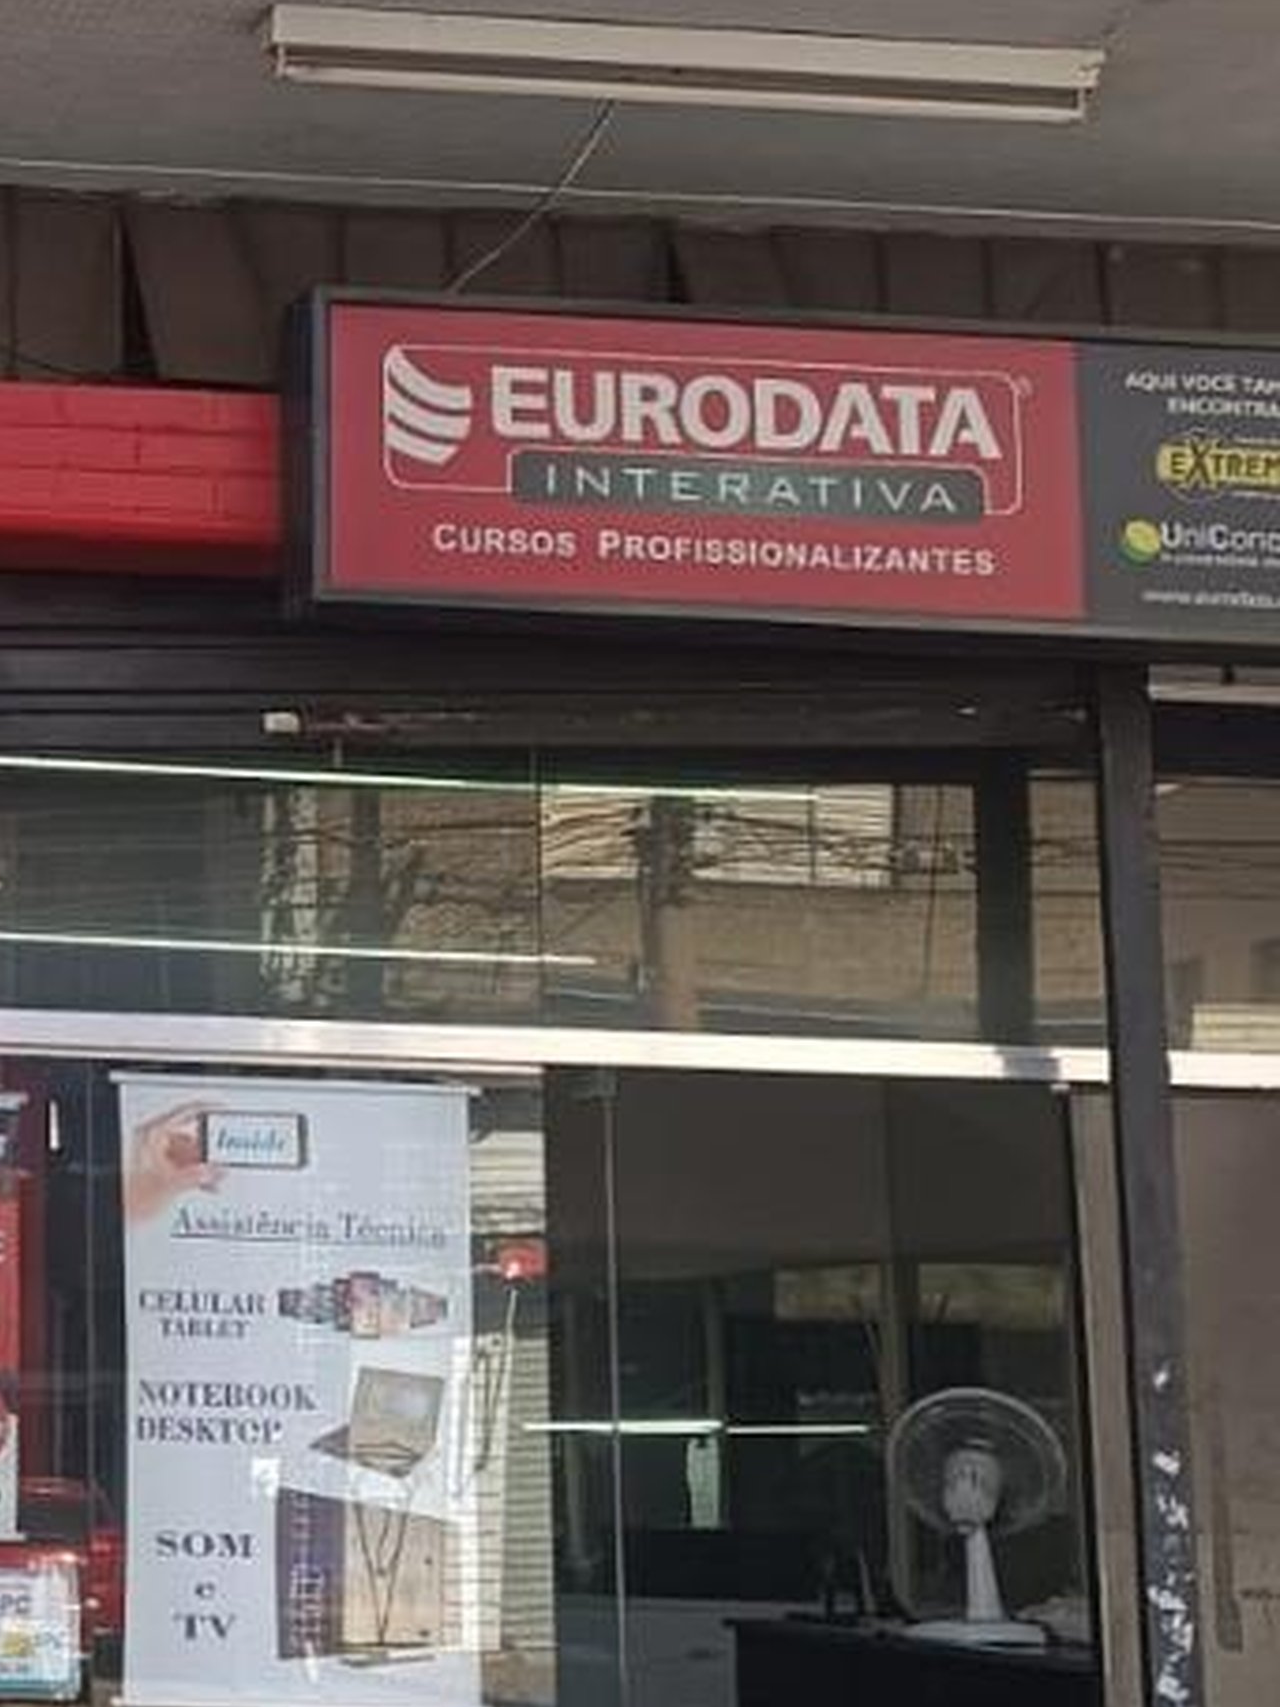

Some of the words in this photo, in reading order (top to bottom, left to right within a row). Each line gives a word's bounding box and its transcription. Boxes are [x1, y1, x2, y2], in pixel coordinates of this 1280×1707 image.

[490, 364, 1004, 460] EURODATA
[544, 462, 959, 513] INTERATIVA
[432, 522, 578, 559] CURSOS
[596, 528, 998, 577] PROFISSIONALIZANTES
[138, 1290, 267, 1318] CELULAR
[159, 1317, 250, 1340] TABLET
[138, 1379, 318, 1412] NOTEBOOK
[137, 1414, 283, 1444] DESKTOP
[155, 1529, 256, 1560] SOM
[173, 1611, 237, 1642] TV
